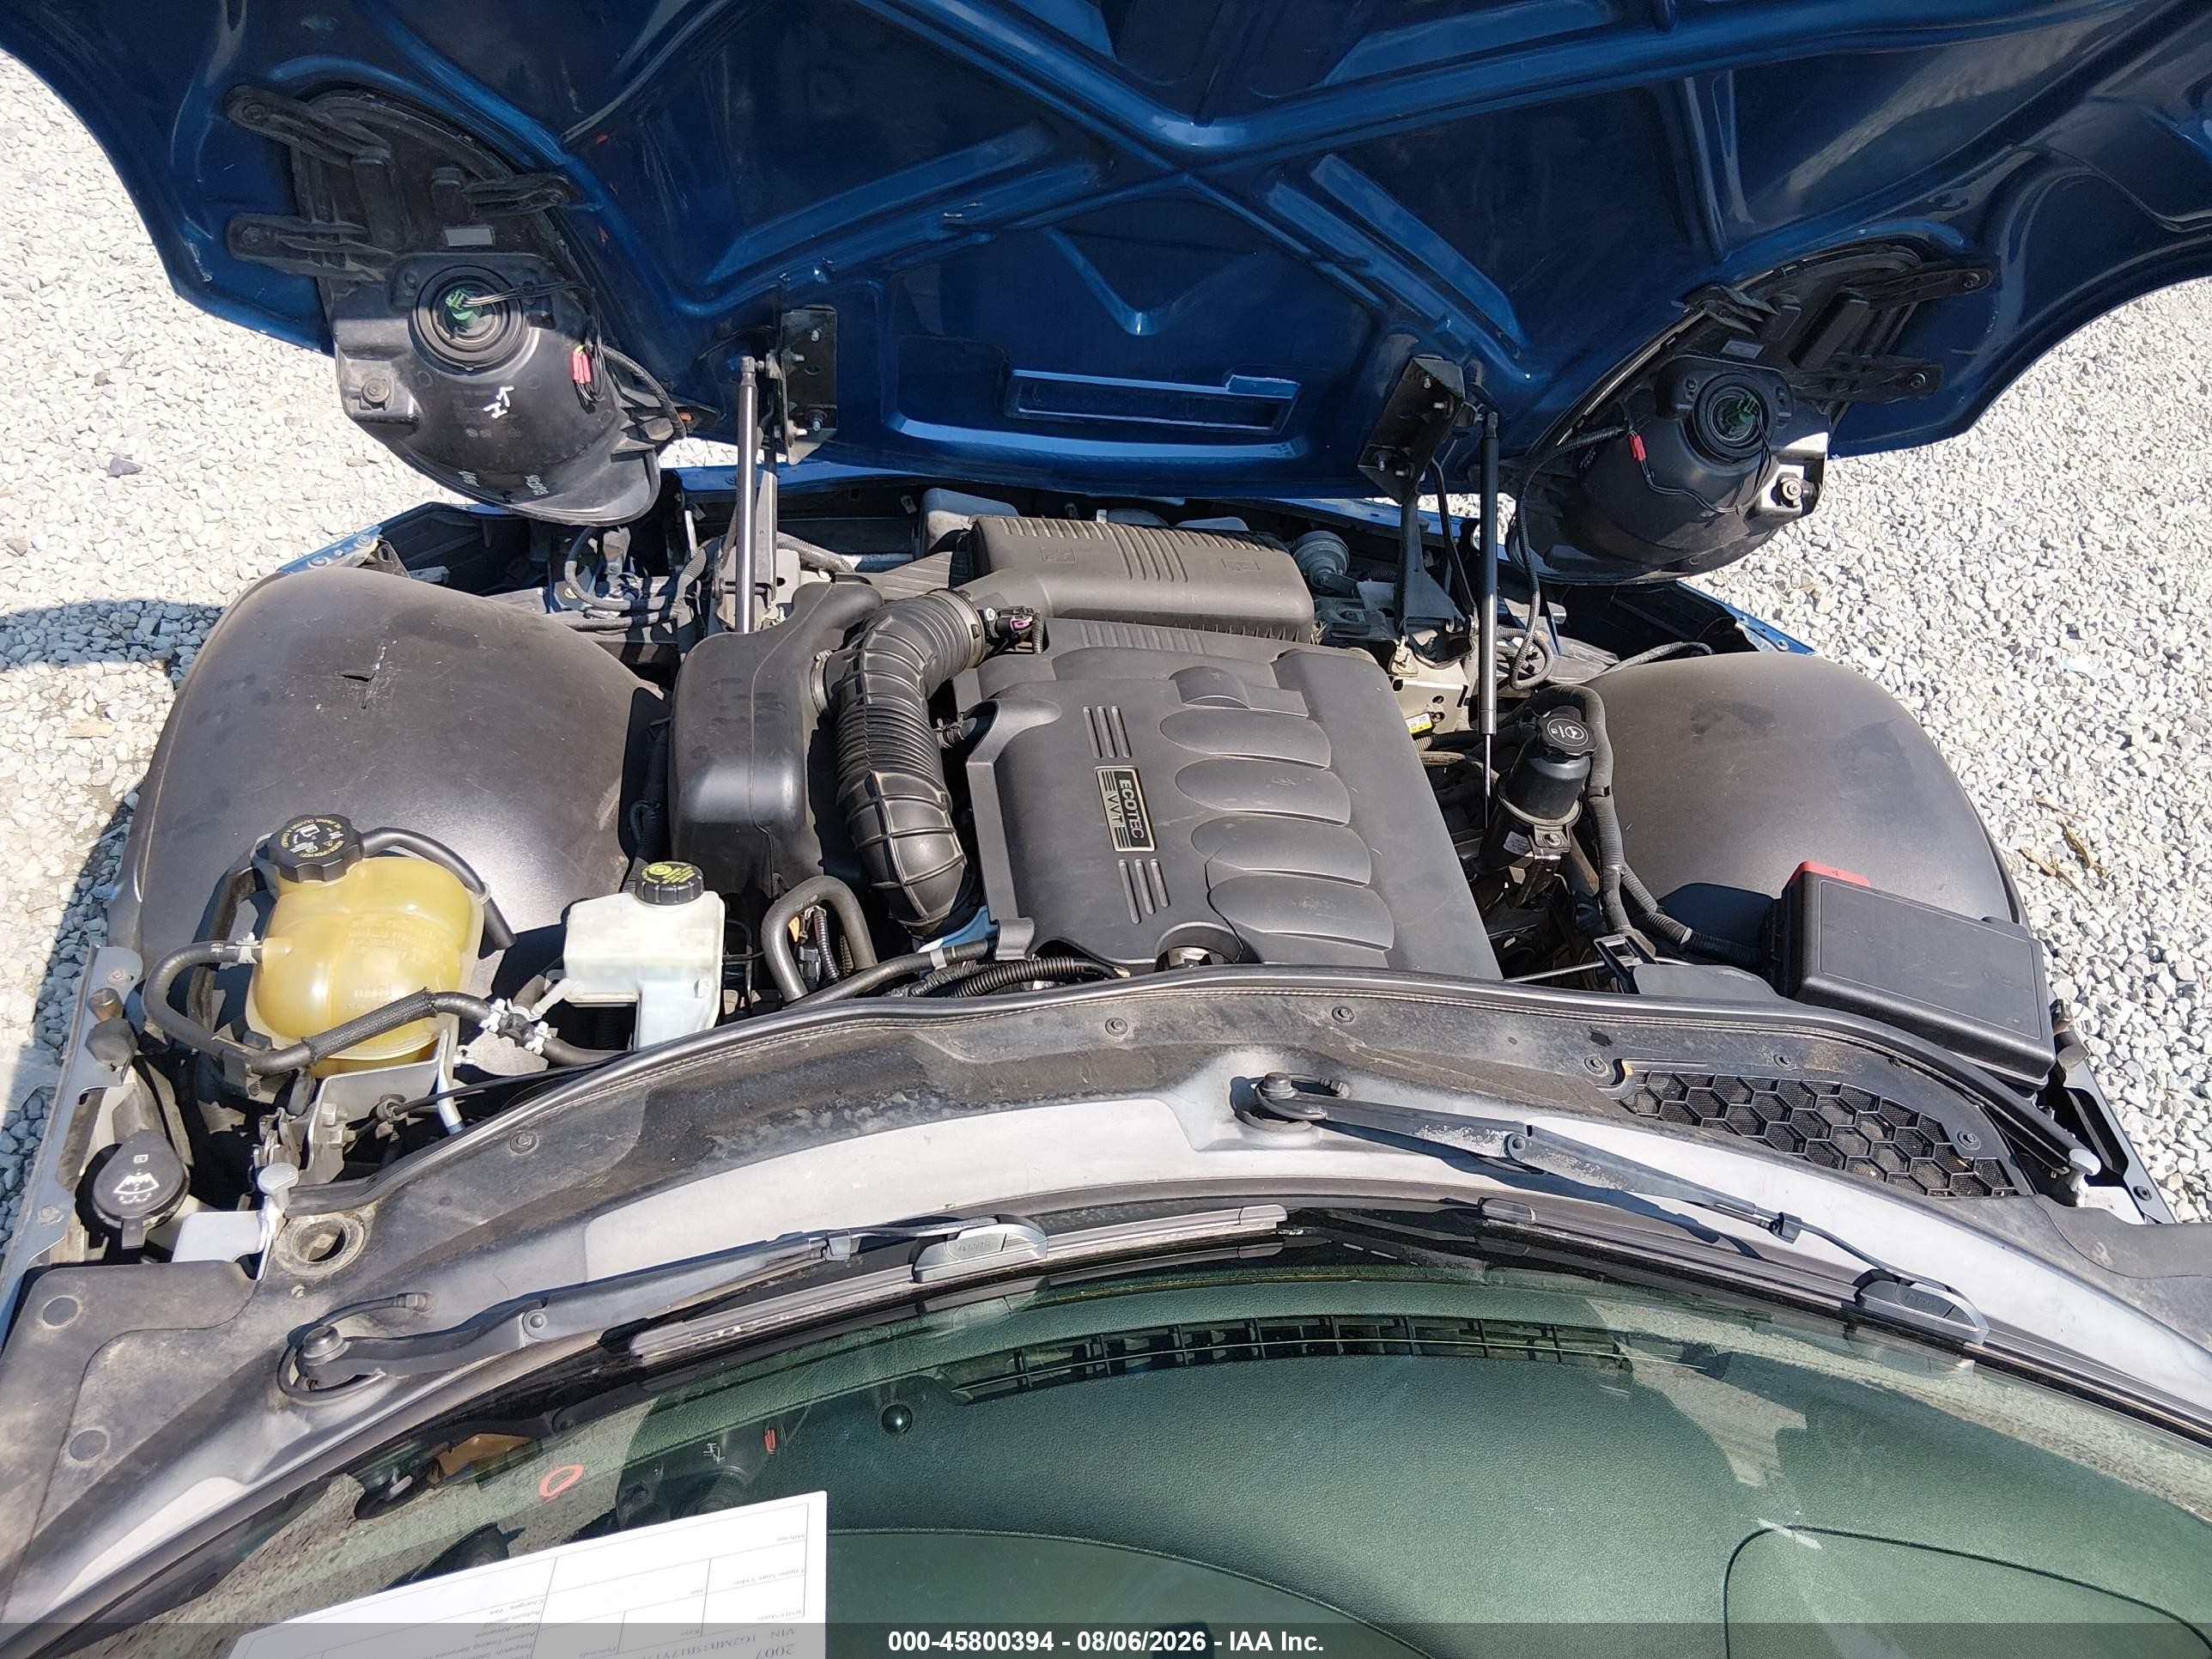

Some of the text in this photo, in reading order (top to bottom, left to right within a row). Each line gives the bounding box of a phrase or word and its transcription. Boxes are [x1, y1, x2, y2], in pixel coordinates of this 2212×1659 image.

[1108, 794, 1123, 823] VVT
[1118, 779, 1145, 839] ECOTEC
[679, 1628, 701, 1638] Keys
[770, 1628, 795, 1640] VIN
[756, 1644, 796, 1659] 2007
